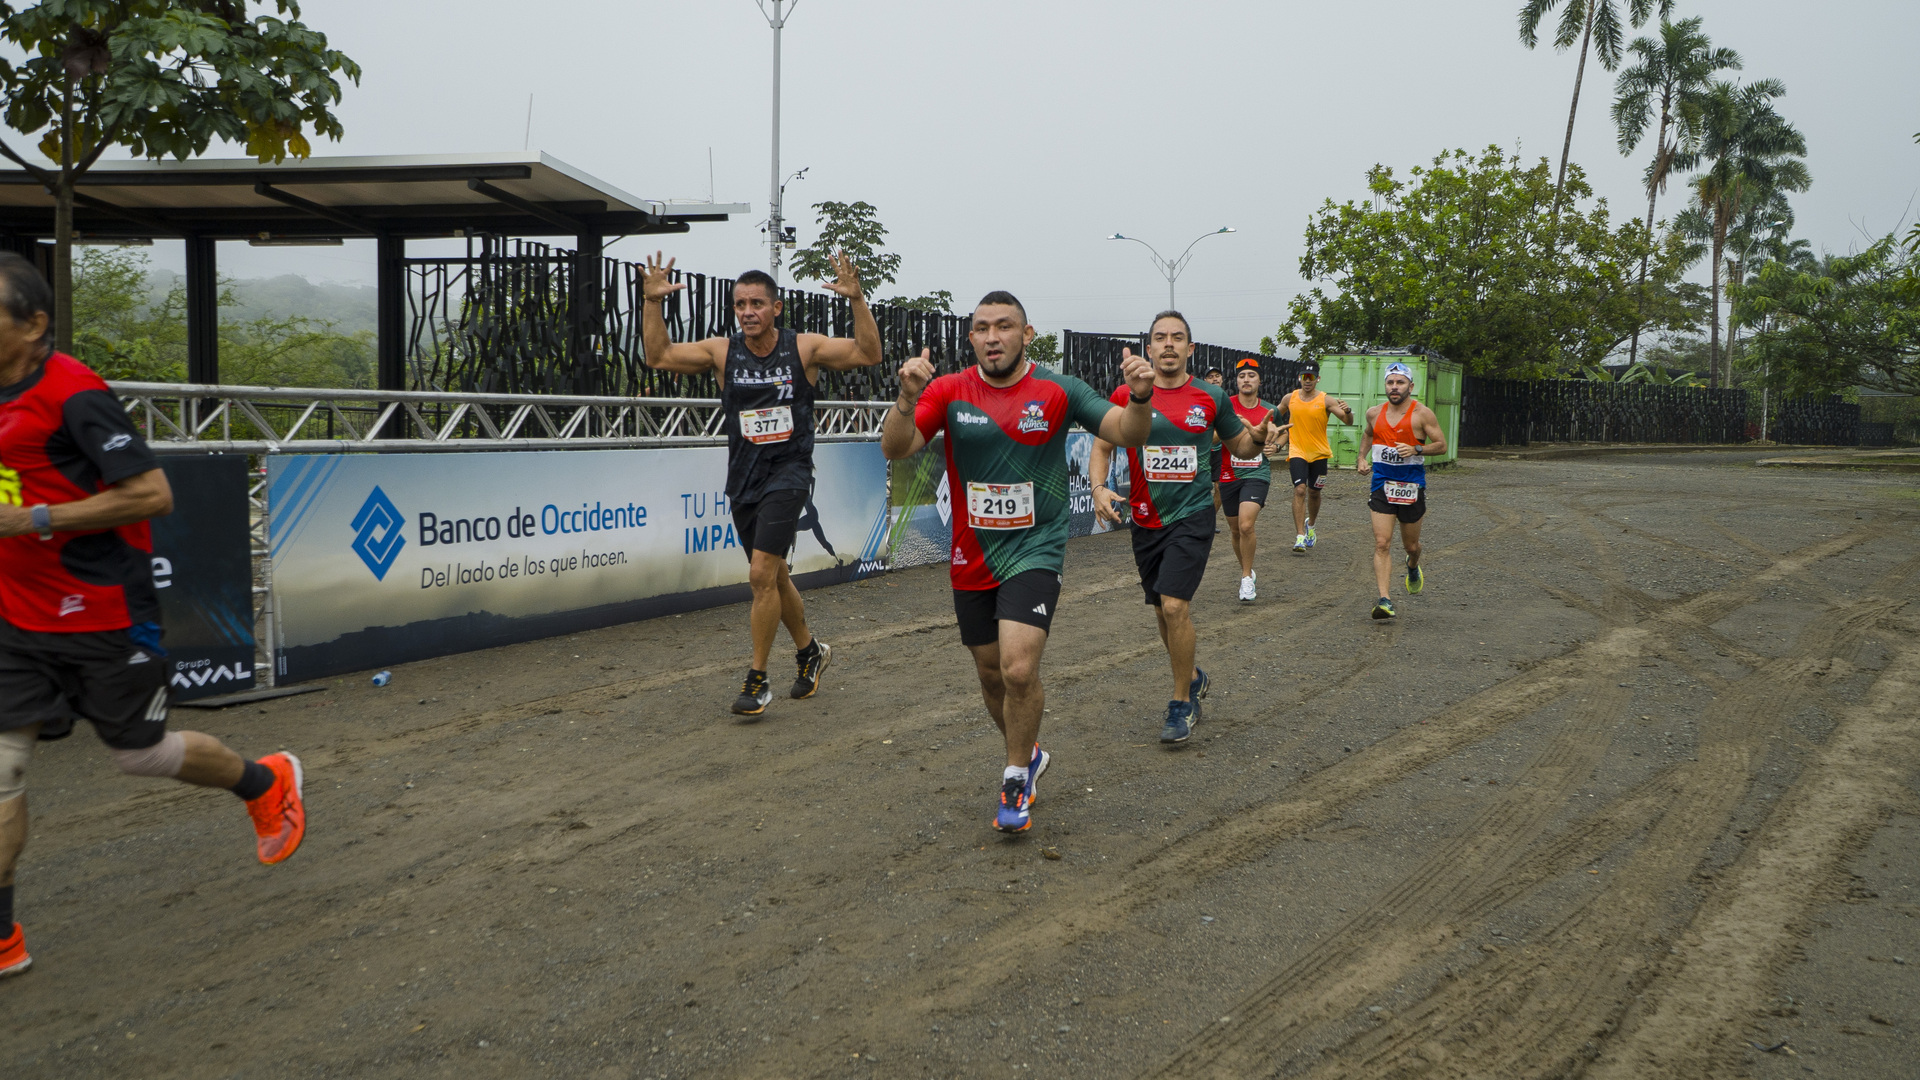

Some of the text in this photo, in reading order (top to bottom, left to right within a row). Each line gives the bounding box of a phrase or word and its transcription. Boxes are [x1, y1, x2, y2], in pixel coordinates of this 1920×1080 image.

[777, 384, 794, 400] 72
[754, 419, 778, 433] 377
[1152, 457, 1188, 471] 2244
[1390, 488, 1412, 498] 1600
[681, 492, 706, 519] TU
[983, 498, 1016, 515] 219
[419, 501, 648, 547] Banco de Occidente
[421, 549, 628, 589] Del lado de los que hacen.
[858, 560, 885, 573] AVAL
[175, 658, 211, 671] Grupo
[170, 661, 252, 689] AVAL
